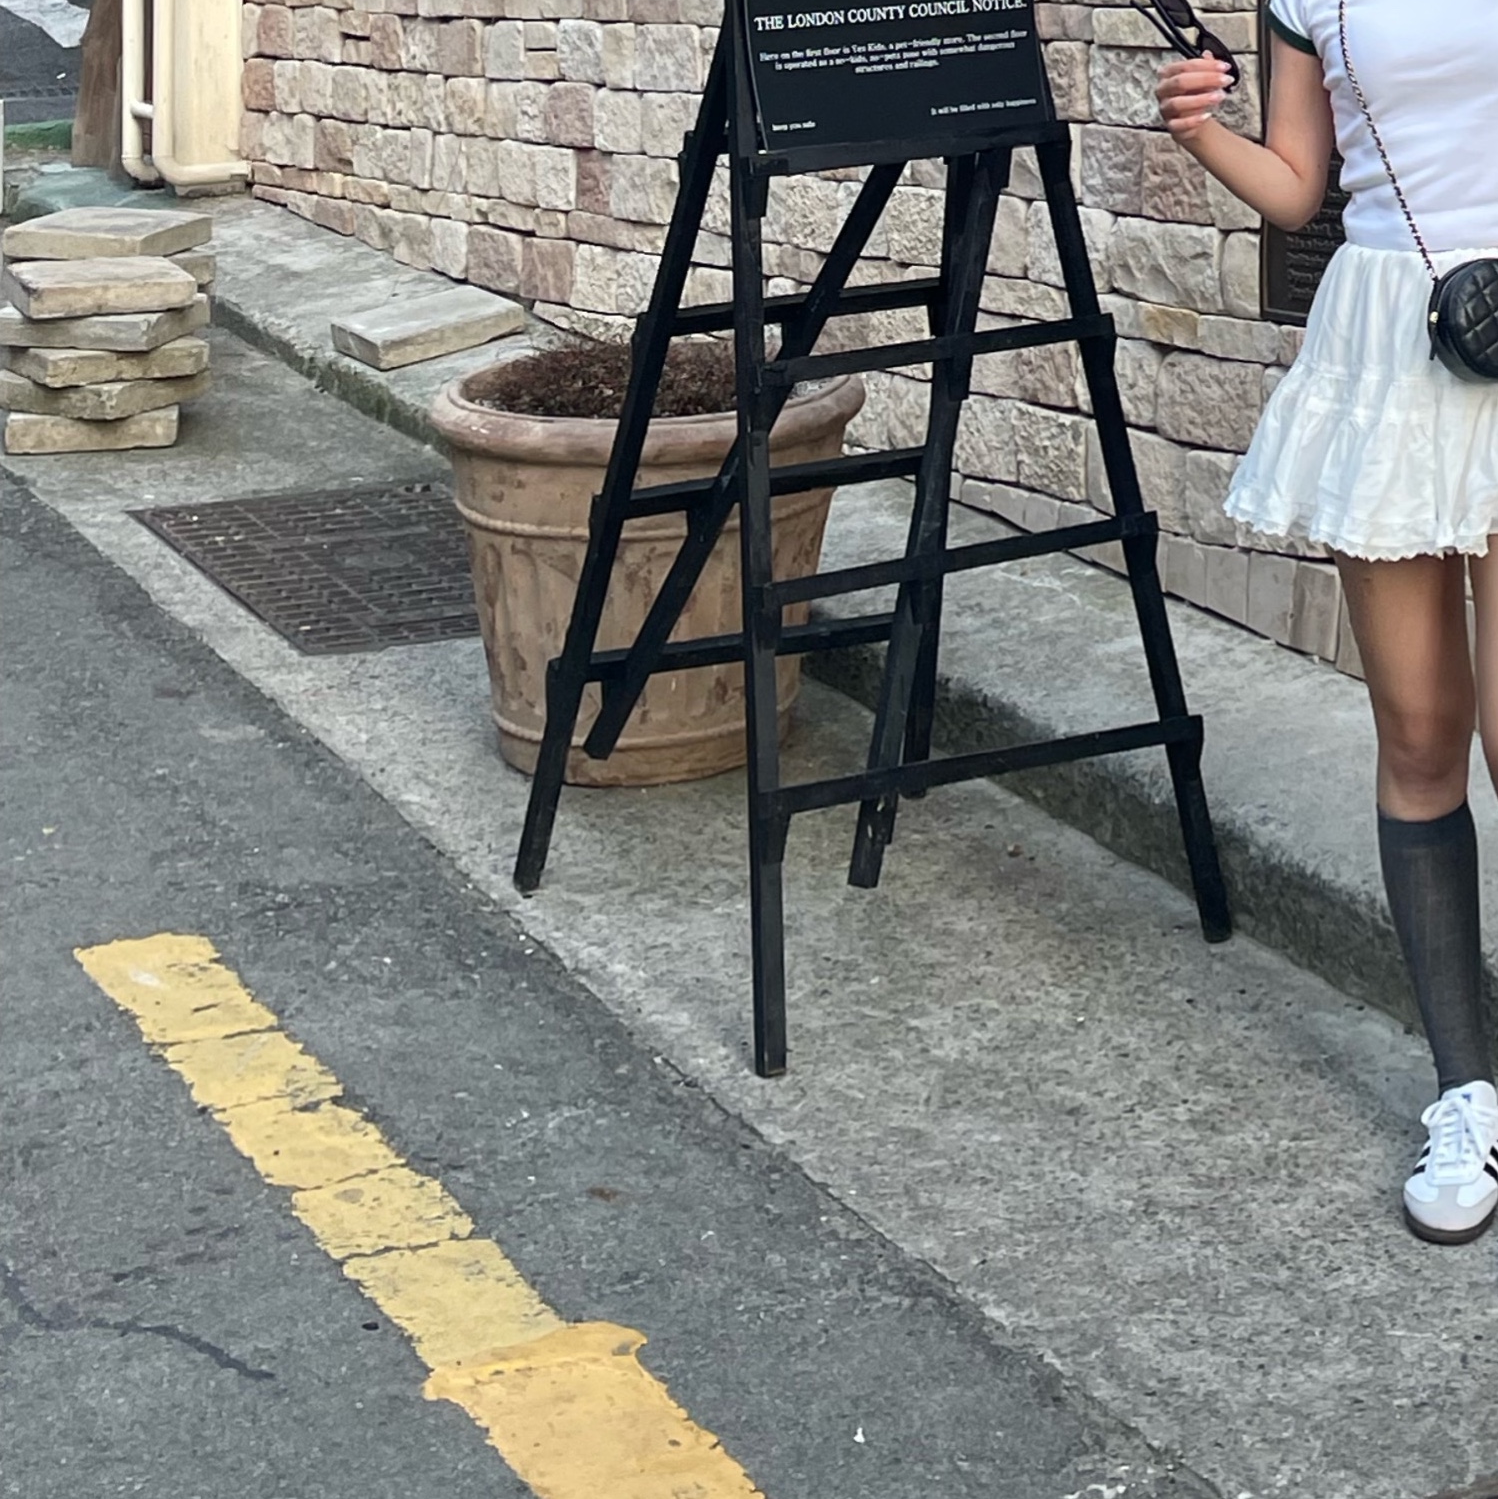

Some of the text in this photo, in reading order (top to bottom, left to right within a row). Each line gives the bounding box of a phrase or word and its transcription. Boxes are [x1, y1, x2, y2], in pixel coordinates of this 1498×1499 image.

[753, 15, 785, 31] THE
[787, 10, 845, 28] LONDON
[847, 5, 906, 23] COUNTY
[908, 0, 970, 18] COUNCIL
[792, 50, 804, 59] the
[806, 48, 821, 58] first
[823, 46, 841, 55] floor
